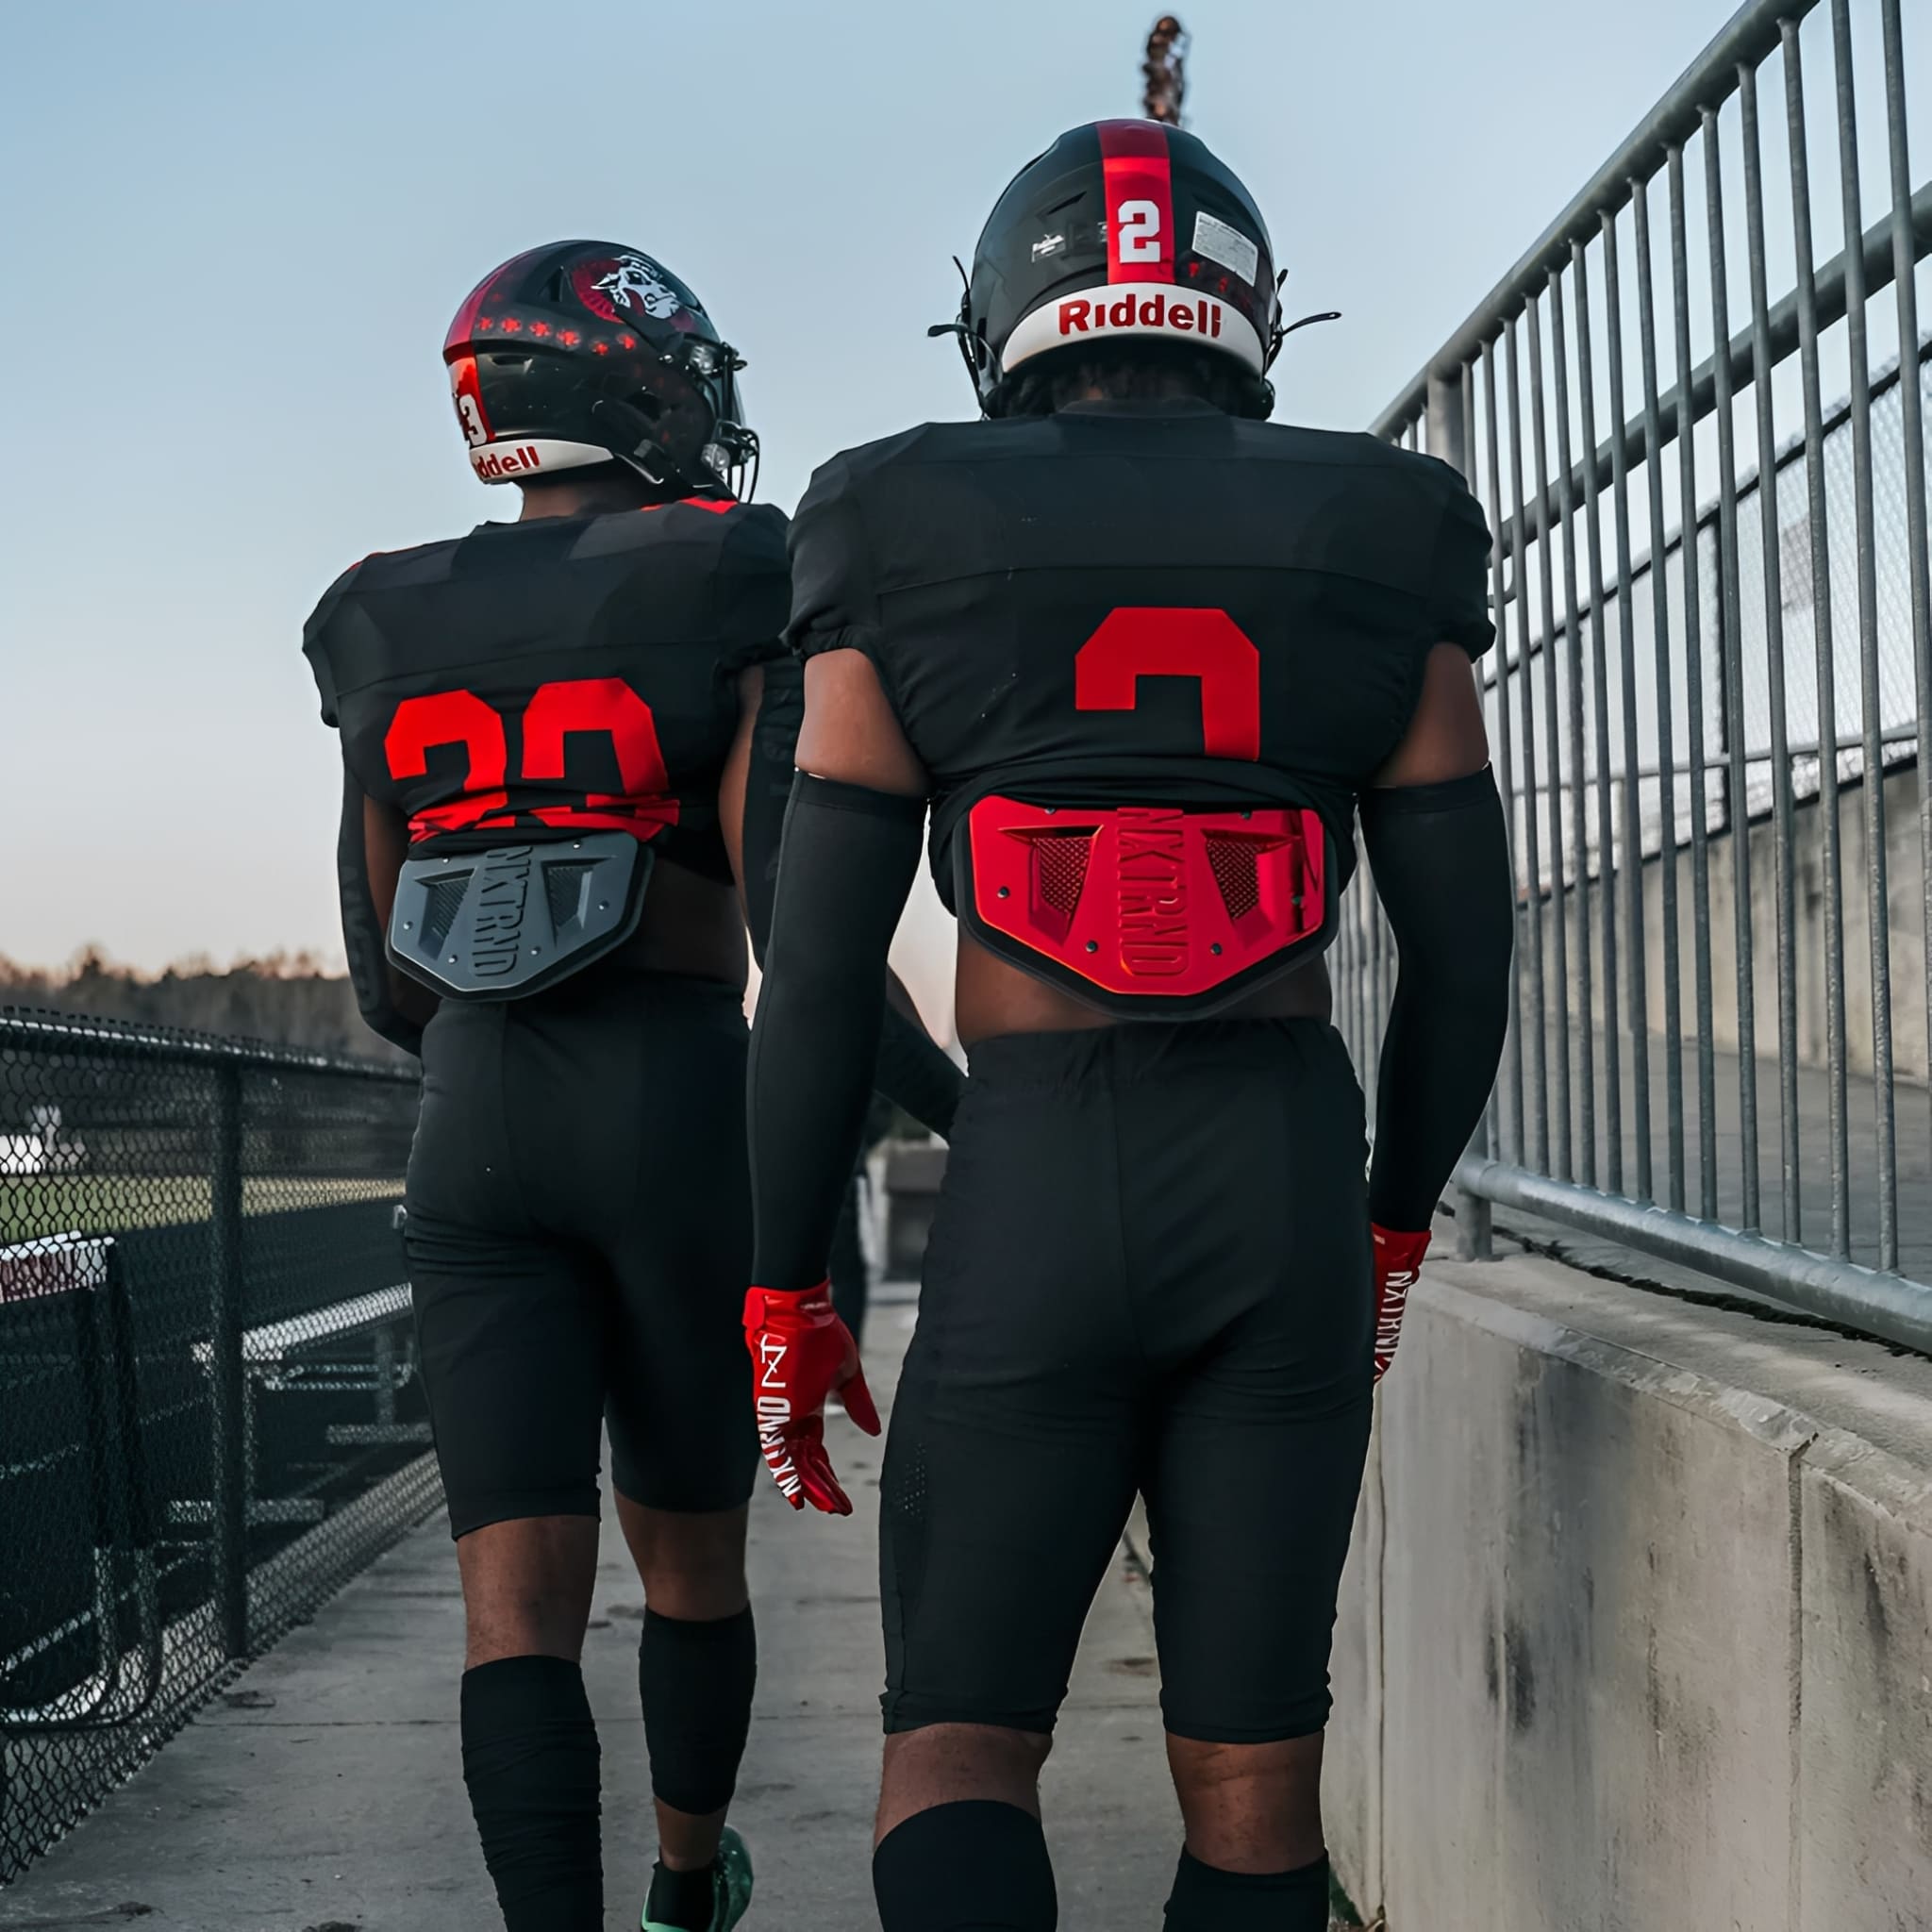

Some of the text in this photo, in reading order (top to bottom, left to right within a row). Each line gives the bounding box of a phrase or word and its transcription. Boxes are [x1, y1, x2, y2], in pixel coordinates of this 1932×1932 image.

[1118, 200, 1160, 263] 2
[1058, 293, 1222, 338] Riddell
[457, 393, 487, 446] 3
[471, 845, 534, 977] NXTRND
[1117, 807, 1189, 977] NXTRND
